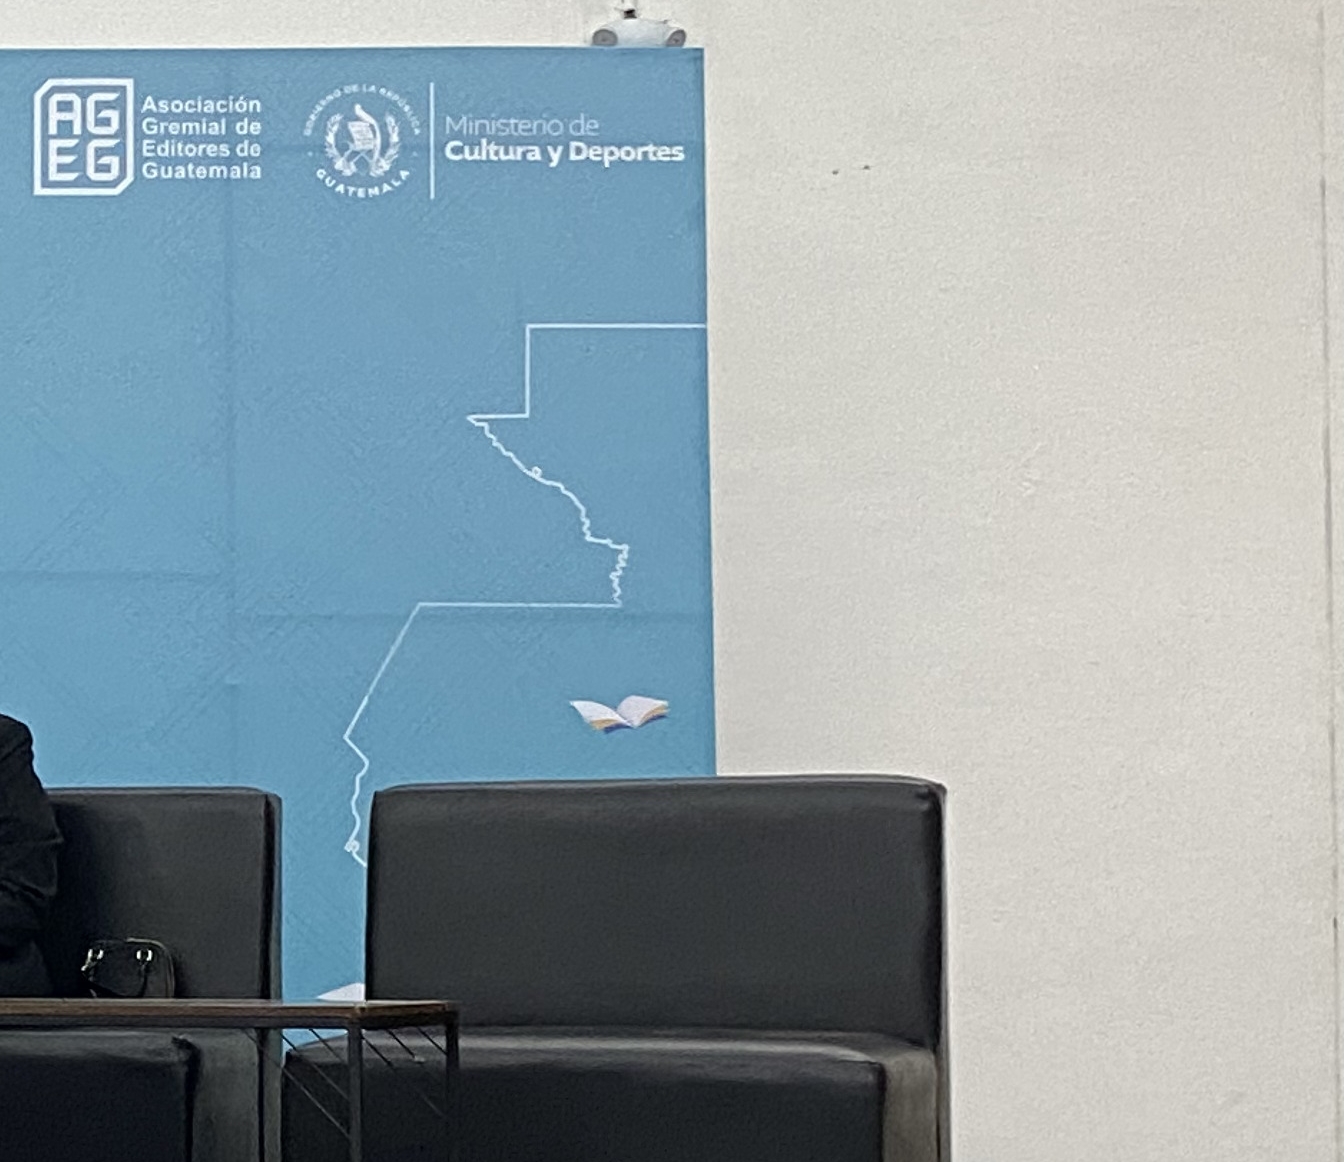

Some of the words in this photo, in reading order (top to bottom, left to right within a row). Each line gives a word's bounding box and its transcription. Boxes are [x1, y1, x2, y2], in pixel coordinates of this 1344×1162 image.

[140, 95, 261, 114] Asociación
[141, 117, 226, 136] Gremial
[235, 117, 262, 136] de
[445, 112, 564, 137] Ministerio
[568, 112, 600, 137] de
[142, 139, 231, 158] Editores
[235, 139, 261, 158] de
[444, 138, 543, 161] Cultura
[546, 145, 564, 168] y
[569, 140, 686, 168] Deportes
[141, 161, 262, 180] Guatemala
[316, 168, 410, 199] GUATEMALA
